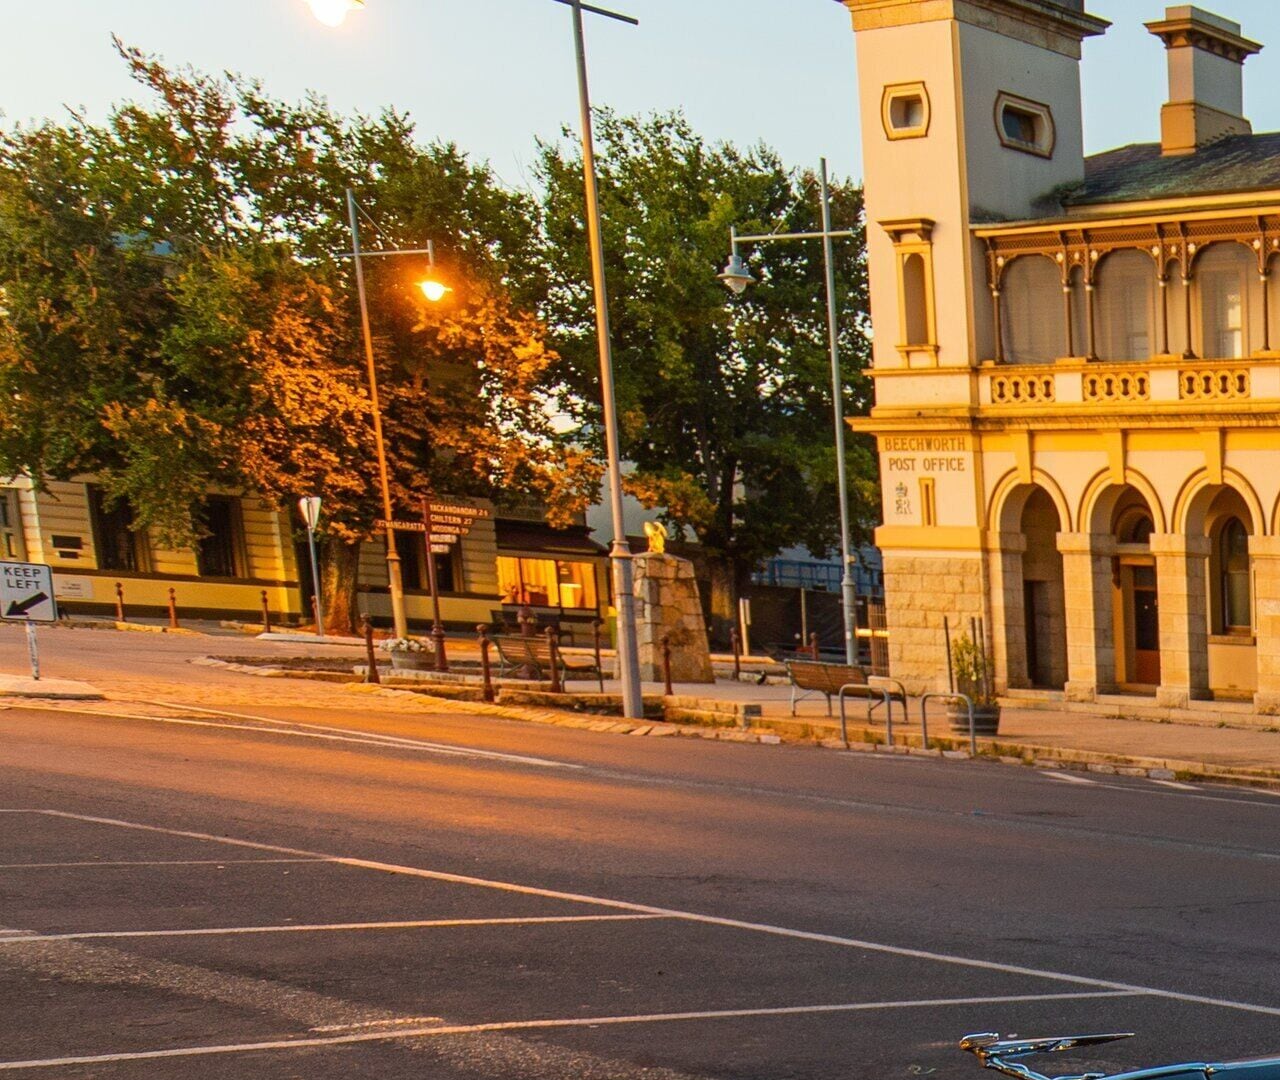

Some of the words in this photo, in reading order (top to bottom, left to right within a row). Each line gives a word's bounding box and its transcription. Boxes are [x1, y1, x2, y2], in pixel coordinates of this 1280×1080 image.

[885, 437, 966, 451] BEECHWORTH
[888, 458, 917, 472] POST
[923, 458, 966, 472] OFFICE
[4, 566, 41, 577] KEEP
[7, 580, 41, 589] LEFT
